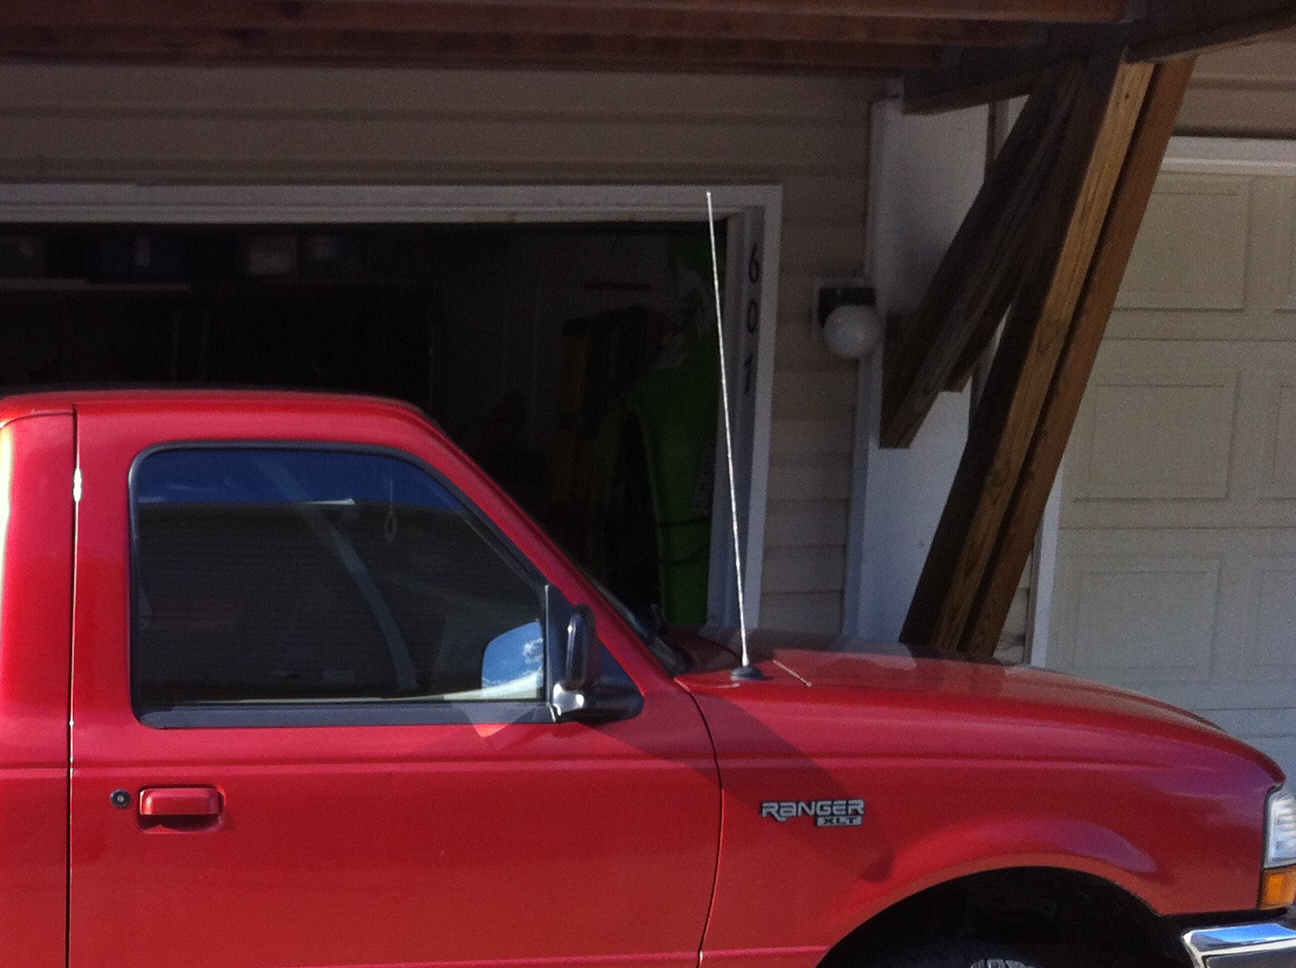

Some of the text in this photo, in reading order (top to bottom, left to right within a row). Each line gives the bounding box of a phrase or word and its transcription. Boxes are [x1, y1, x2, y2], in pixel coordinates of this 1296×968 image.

[744, 244, 760, 396] 601
[761, 799, 864, 821] RANGER
[821, 816, 856, 825] XLT
